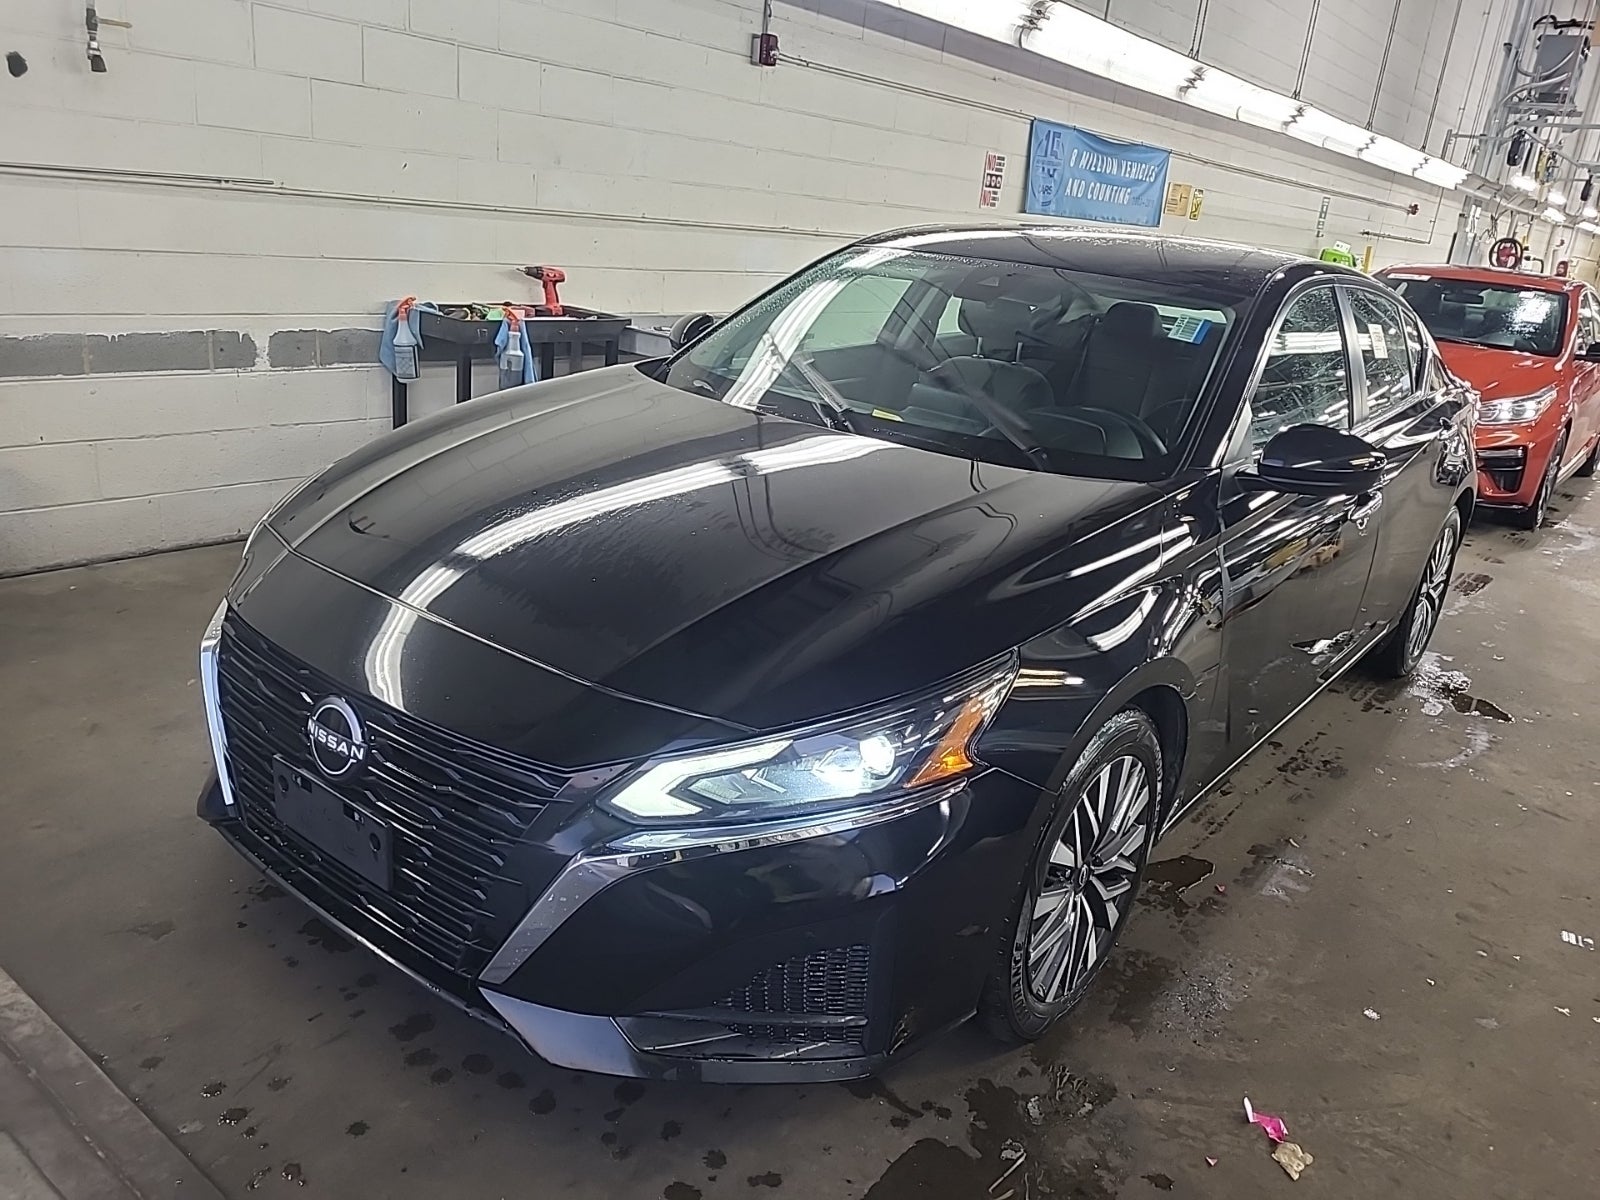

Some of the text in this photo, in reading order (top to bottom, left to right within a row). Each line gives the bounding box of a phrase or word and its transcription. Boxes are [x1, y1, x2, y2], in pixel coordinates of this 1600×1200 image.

[1079, 151, 1118, 175] MILLION
[1121, 160, 1159, 183] VEHICLES
[1064, 178, 1086, 198] AND
[1087, 182, 1132, 205] COUNTING
[308, 718, 364, 760] NISSAN
